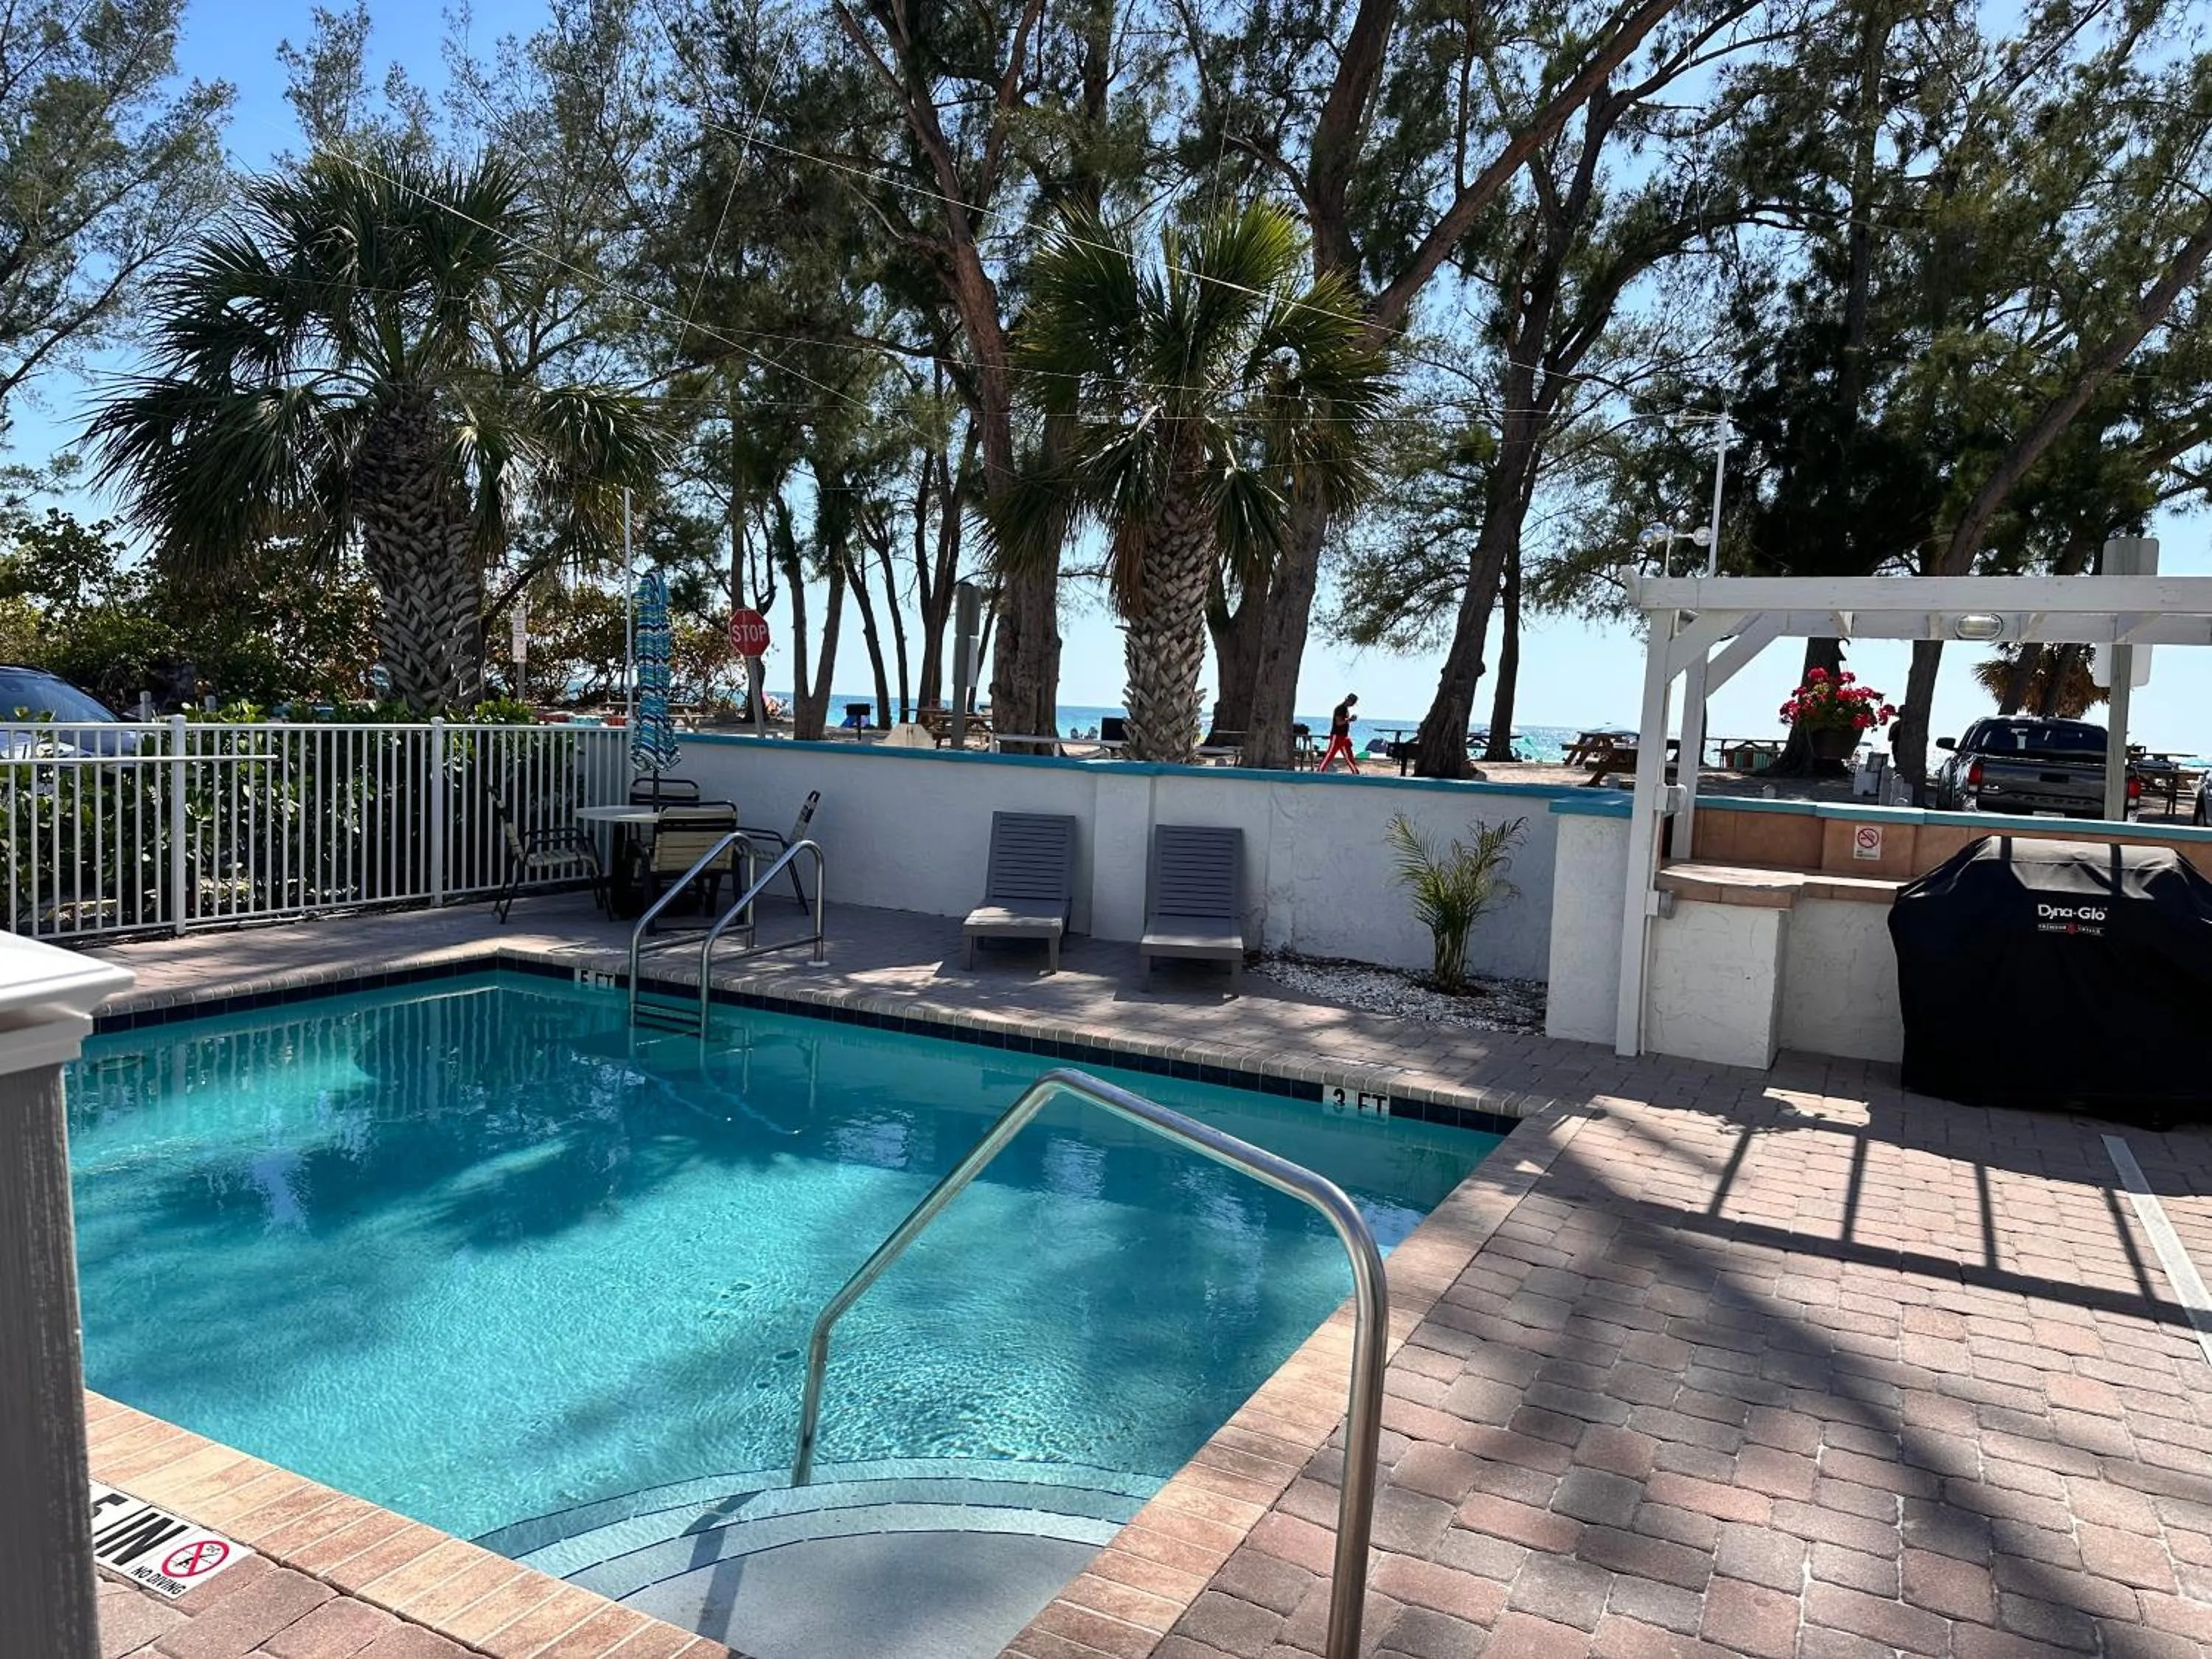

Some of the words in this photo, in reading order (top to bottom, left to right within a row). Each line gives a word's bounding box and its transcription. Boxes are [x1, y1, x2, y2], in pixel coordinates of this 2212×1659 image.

[732, 625, 766, 642] STOP
[2038, 904, 2105, 921] Dyna-Glo
[1333, 1088, 1345, 1107] 3
[1357, 1093, 1387, 1113] FT
[94, 1512, 189, 1566] IN
[131, 1566, 153, 1579] NO
[145, 1573, 187, 1595] DIVING
